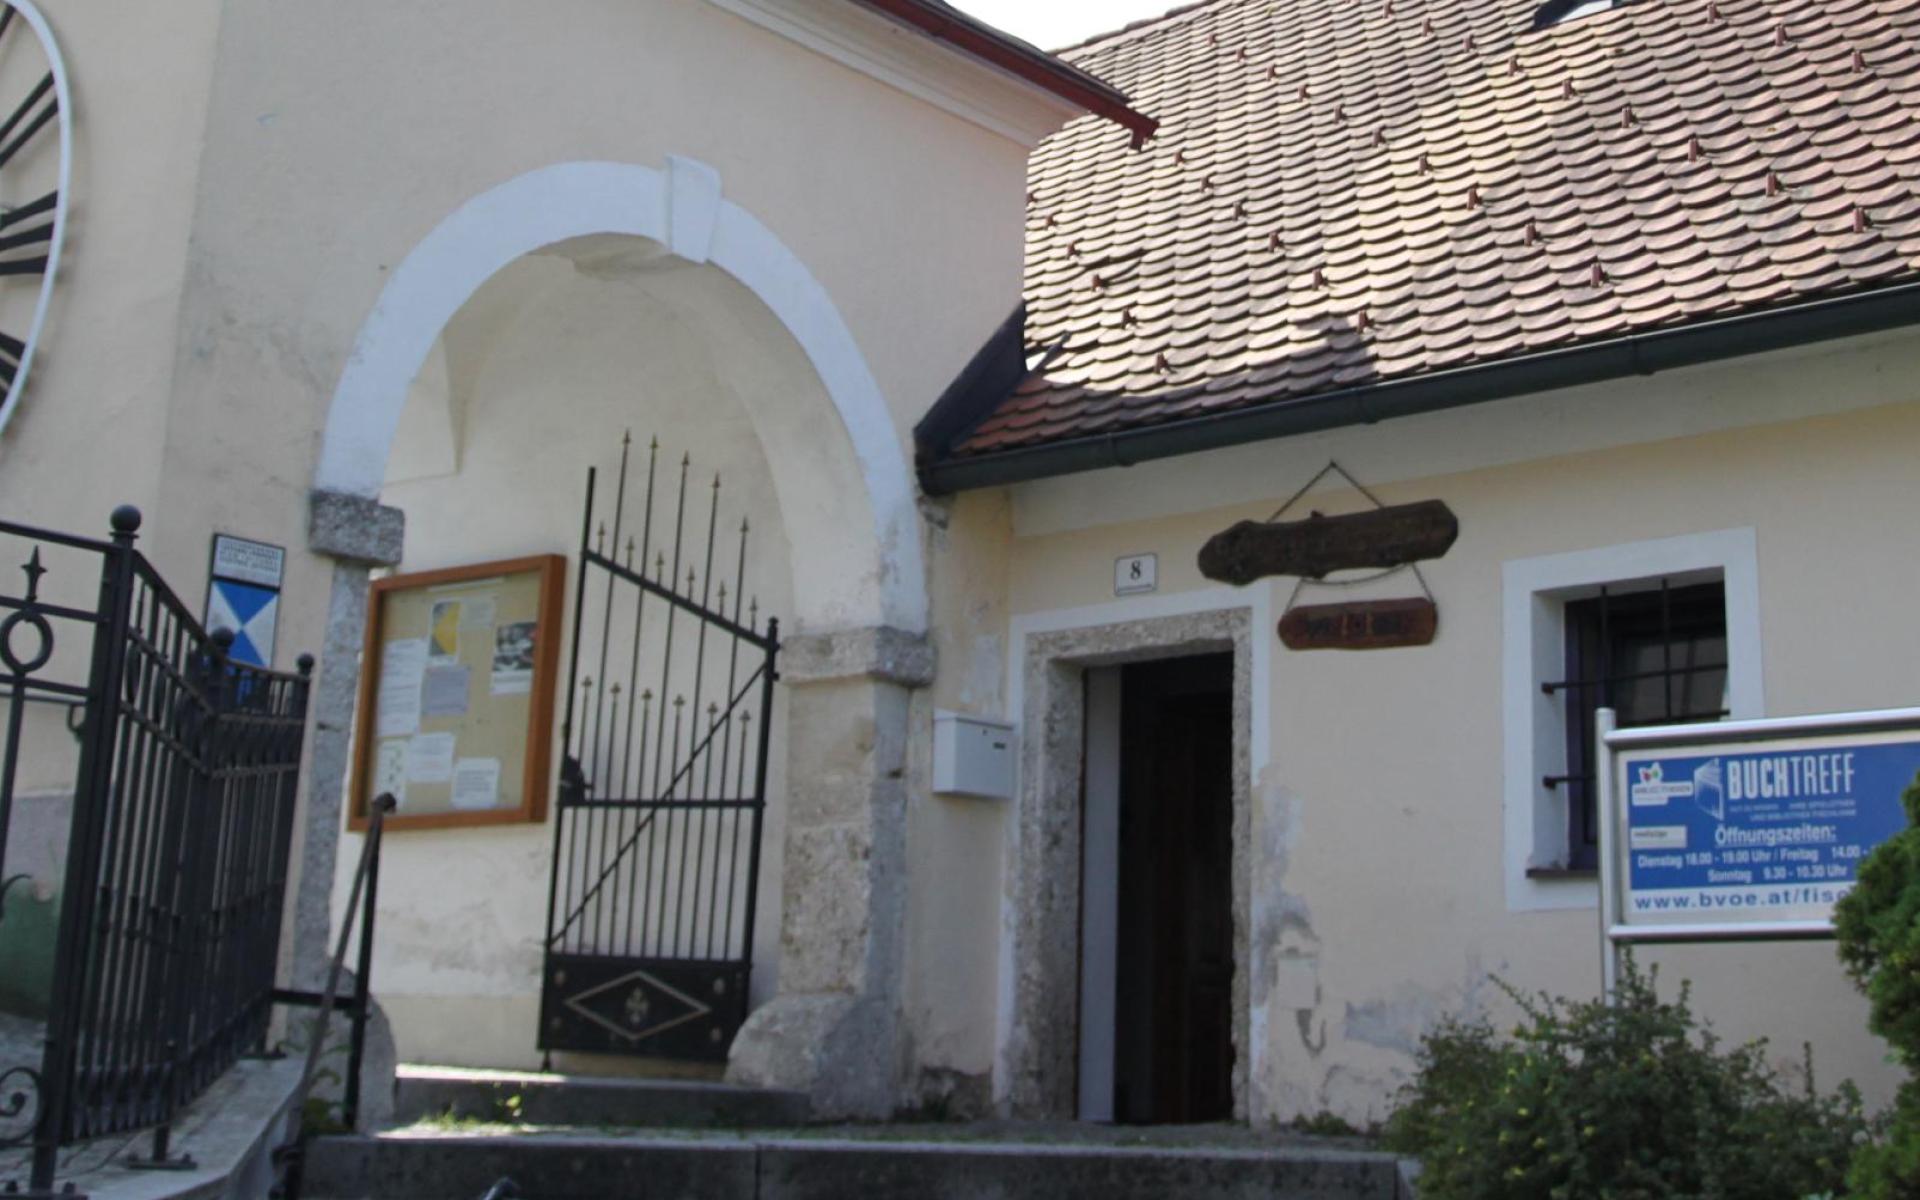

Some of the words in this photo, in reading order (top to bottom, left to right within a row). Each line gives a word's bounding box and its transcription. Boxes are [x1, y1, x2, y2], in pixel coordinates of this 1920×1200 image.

[1130, 559, 1142, 581] 8
[1727, 753, 1855, 800] BUCHTREFF
[1715, 822, 1837, 847] Öffnungszeiten:
[1751, 848, 1771, 863] Uhr
[1780, 847, 1819, 863] Freitag
[1707, 868, 1752, 884] Sonntag
[1827, 863, 1847, 878] Uhr
[1635, 887, 1854, 909] www.bvoe.at/fisc
